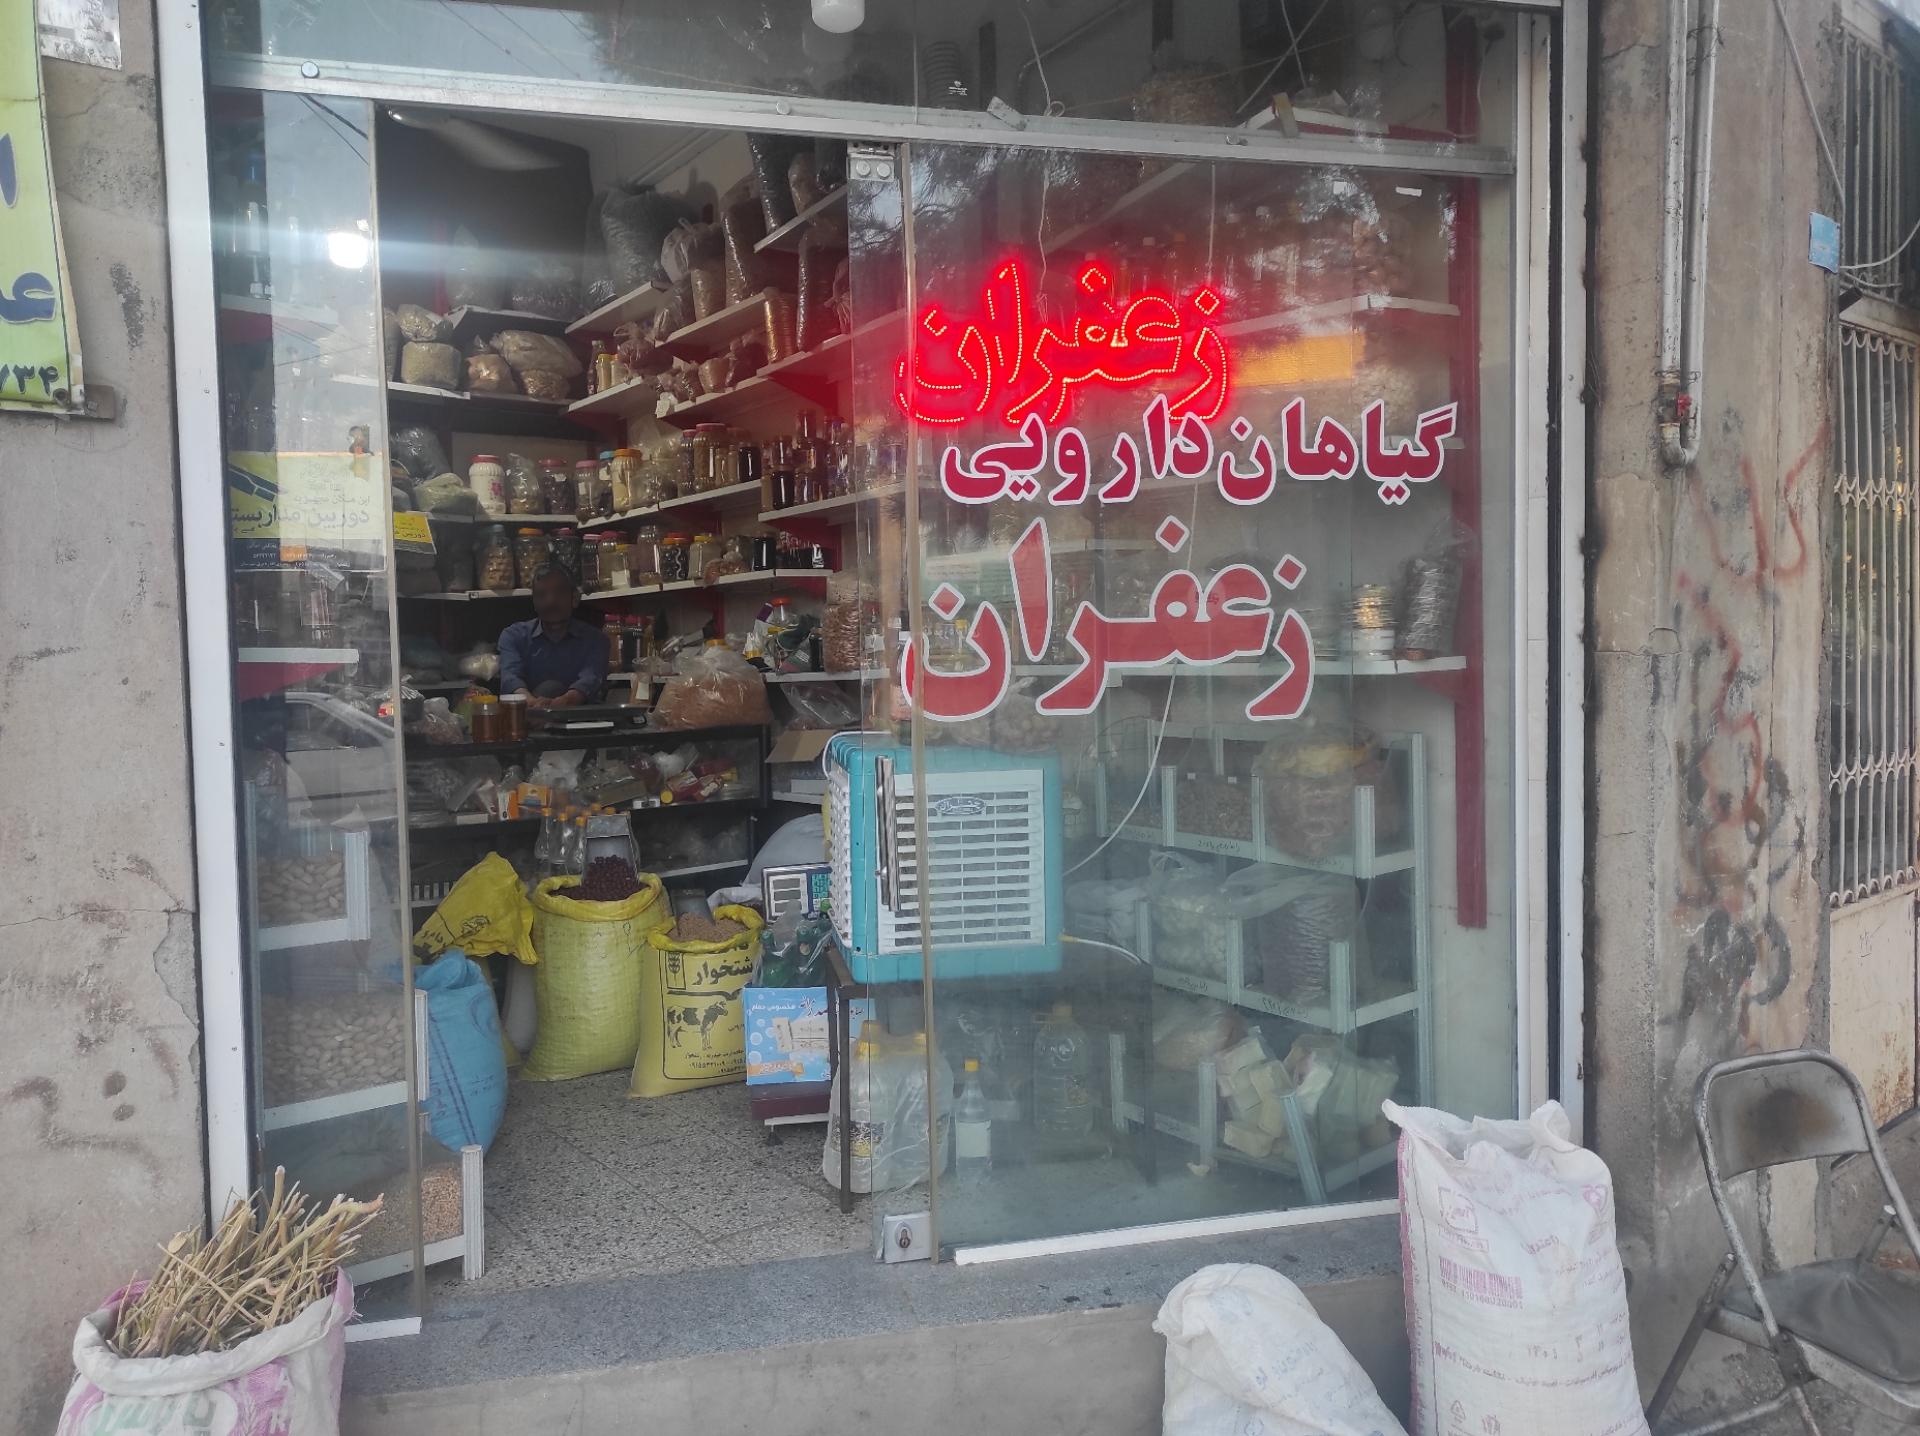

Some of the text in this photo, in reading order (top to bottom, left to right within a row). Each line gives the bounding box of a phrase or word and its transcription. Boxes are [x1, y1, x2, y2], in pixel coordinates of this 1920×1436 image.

[898, 263, 1229, 424] زعفران
[939, 394, 1459, 506] گیاهان دارویی
[232, 503, 301, 529] مداربست
[901, 515, 1316, 723] زعفران
[691, 956, 753, 986] شتخوار
